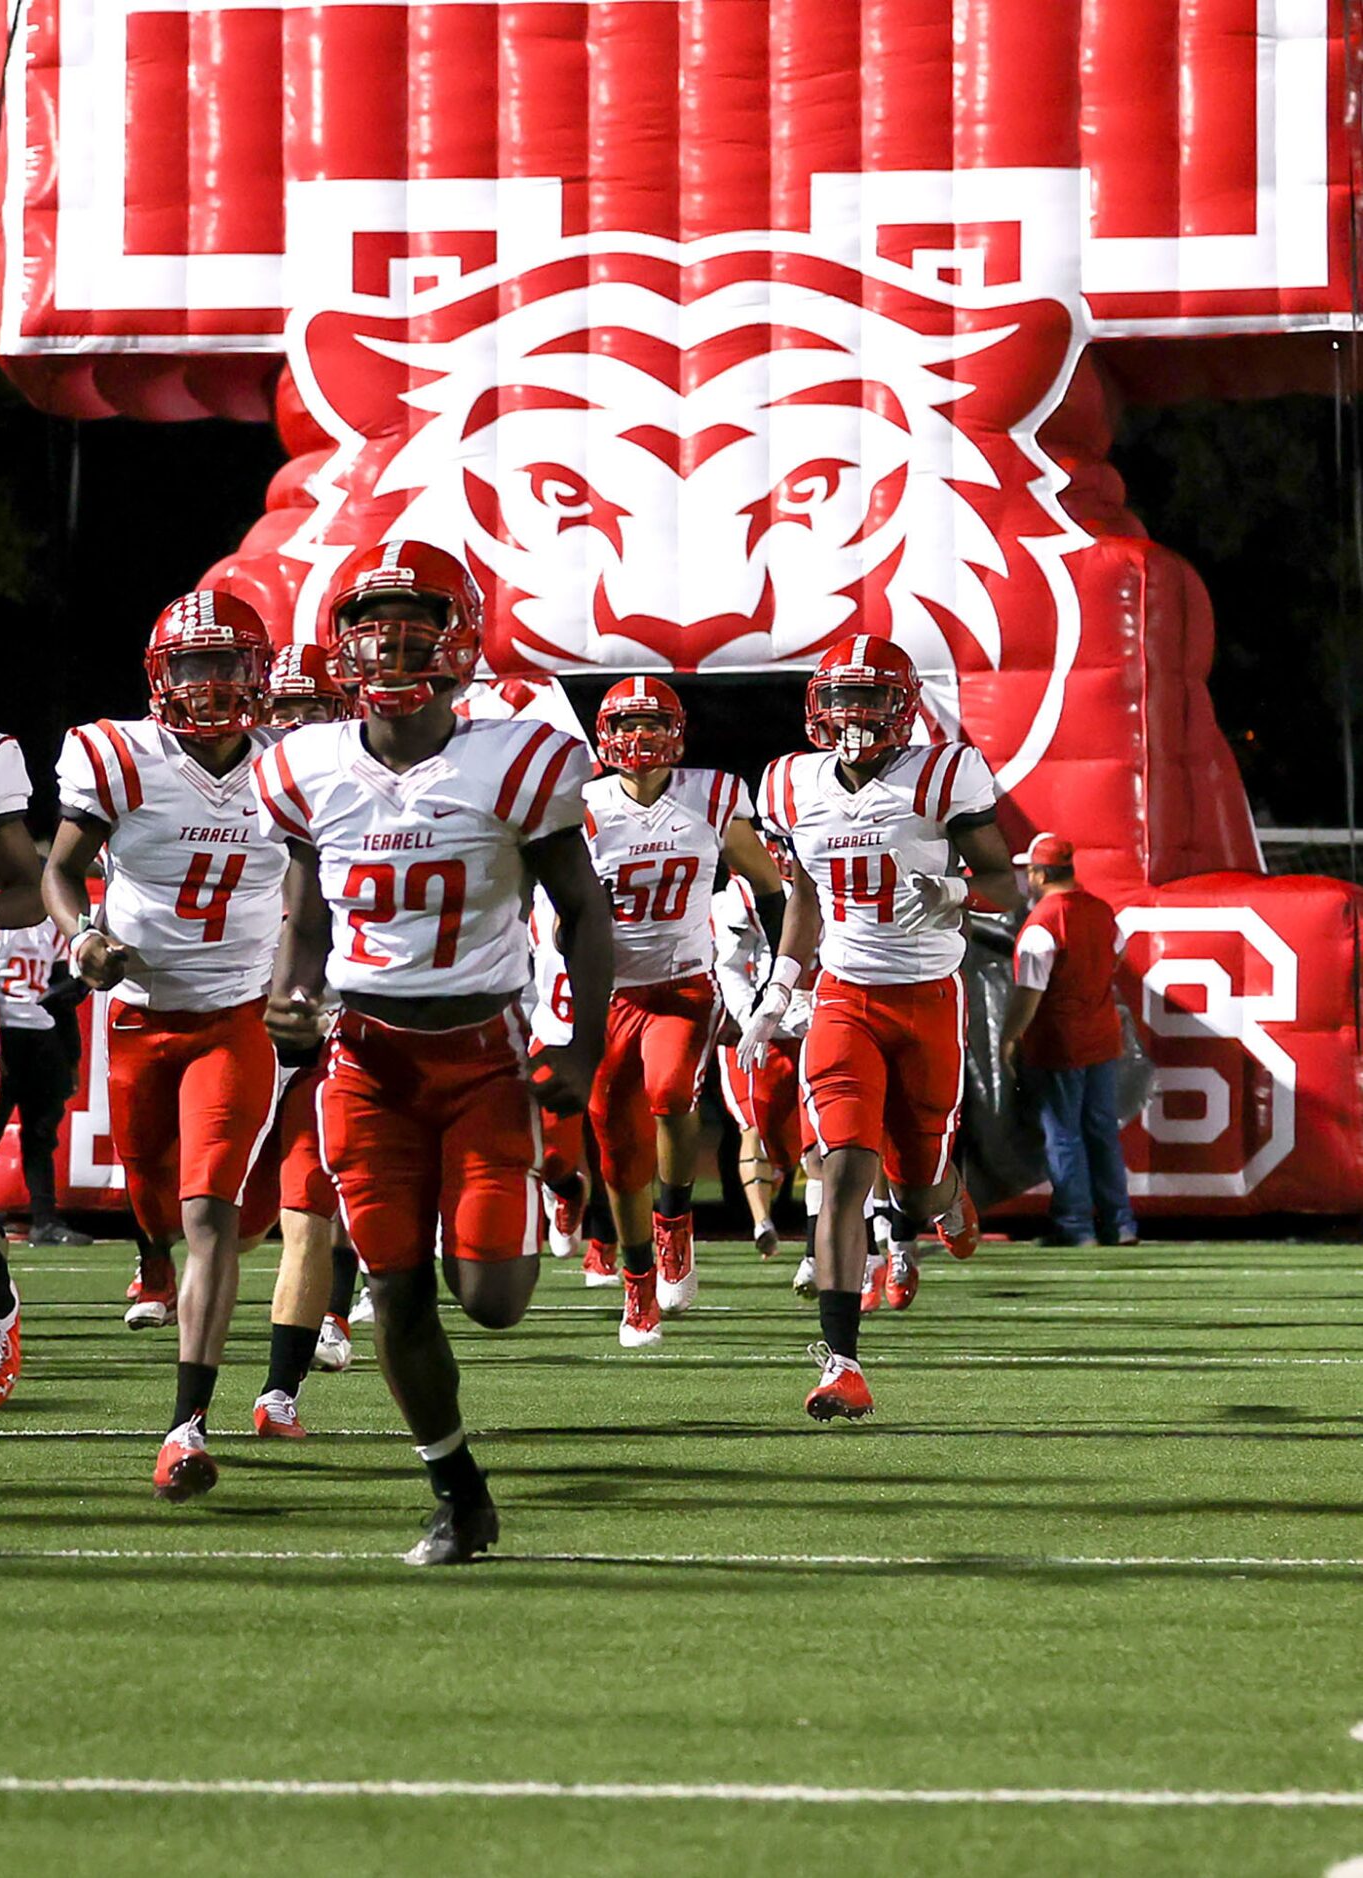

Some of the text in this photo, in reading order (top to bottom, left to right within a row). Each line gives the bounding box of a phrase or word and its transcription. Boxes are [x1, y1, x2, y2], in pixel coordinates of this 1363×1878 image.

[178, 826, 250, 844] TERRELL
[362, 831, 436, 851] TERRELL
[629, 840, 677, 856] TERRELL
[827, 832, 884, 849] TERRELL
[175, 852, 248, 943] 4
[614, 856, 700, 923] 50
[829, 852, 898, 925] 14
[341, 859, 467, 969] 27
[2, 956, 46, 999] 24
